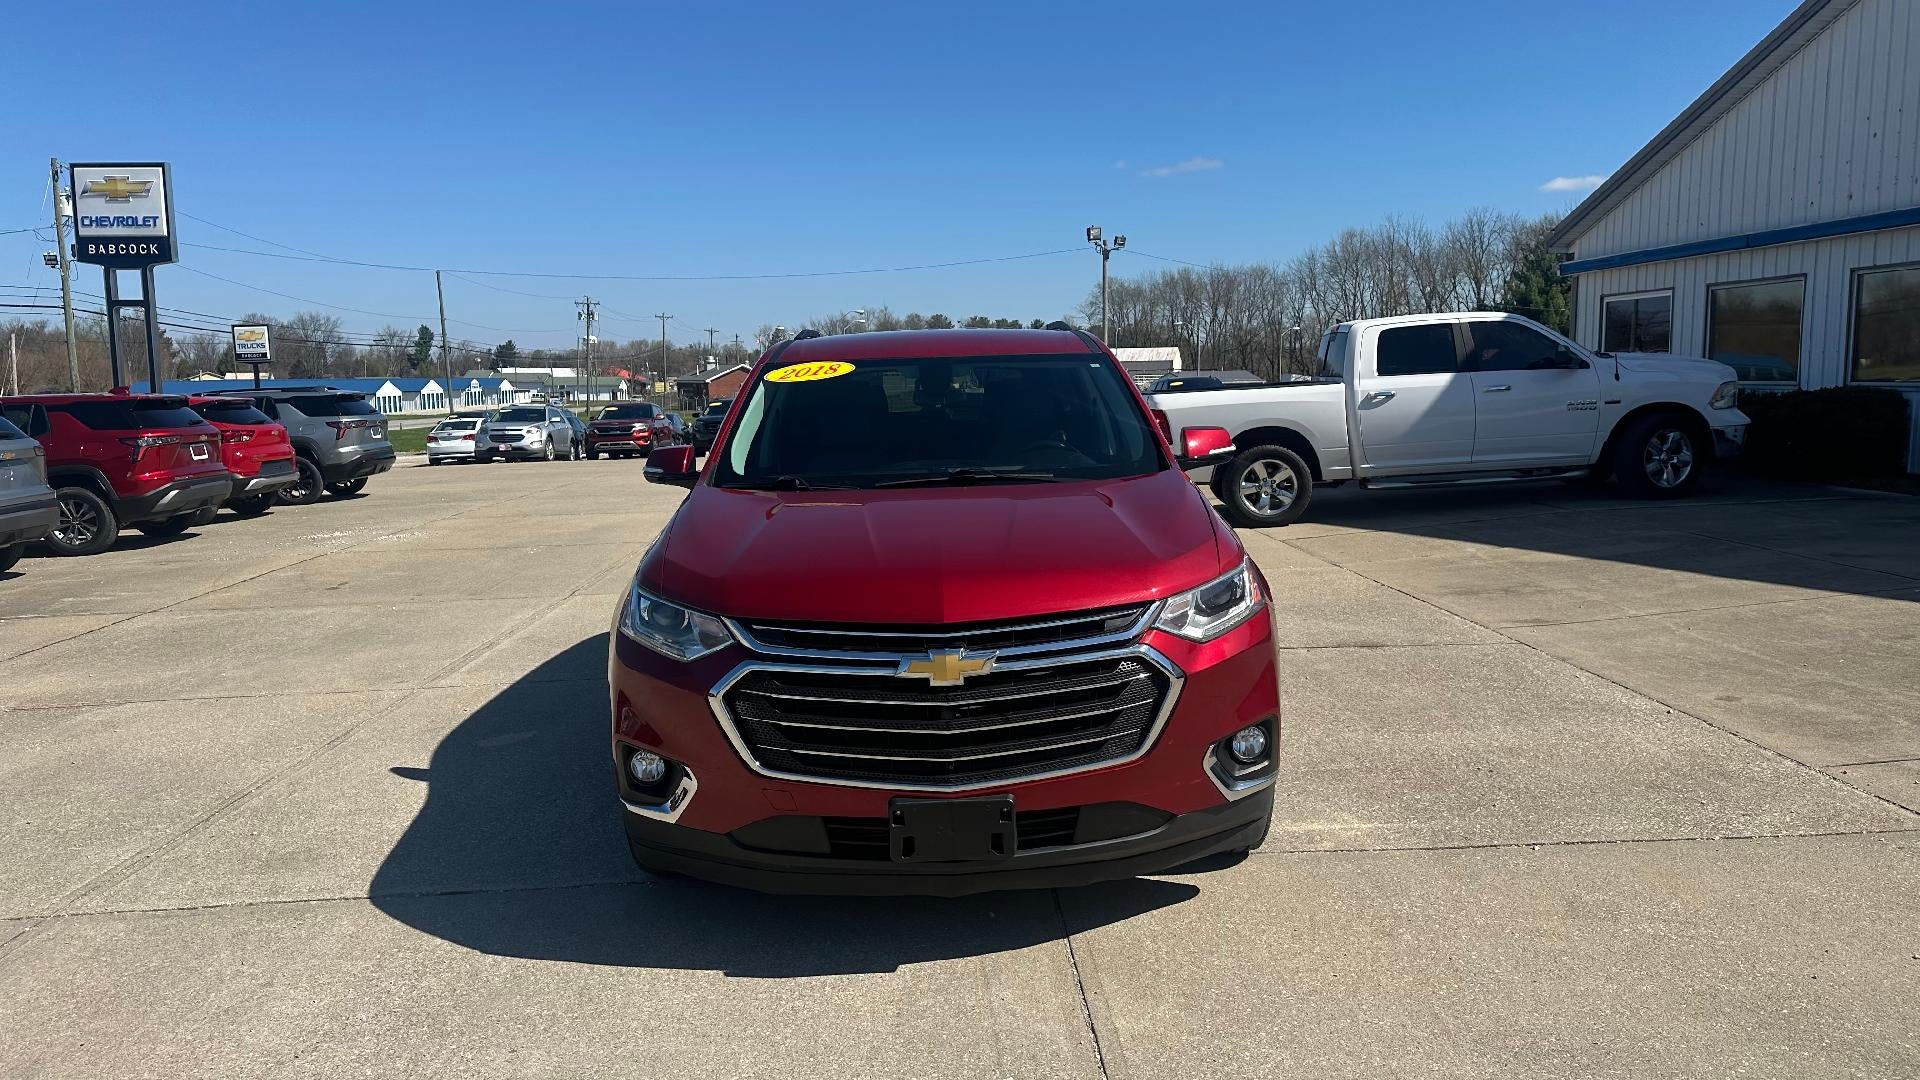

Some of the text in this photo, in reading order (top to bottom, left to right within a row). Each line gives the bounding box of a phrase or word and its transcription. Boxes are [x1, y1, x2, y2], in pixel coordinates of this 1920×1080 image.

[80, 215, 160, 228] CHEVROLET
[88, 243, 159, 255] BABCOCK
[236, 342, 266, 350] TRUCKS
[778, 363, 841, 380] 2018
